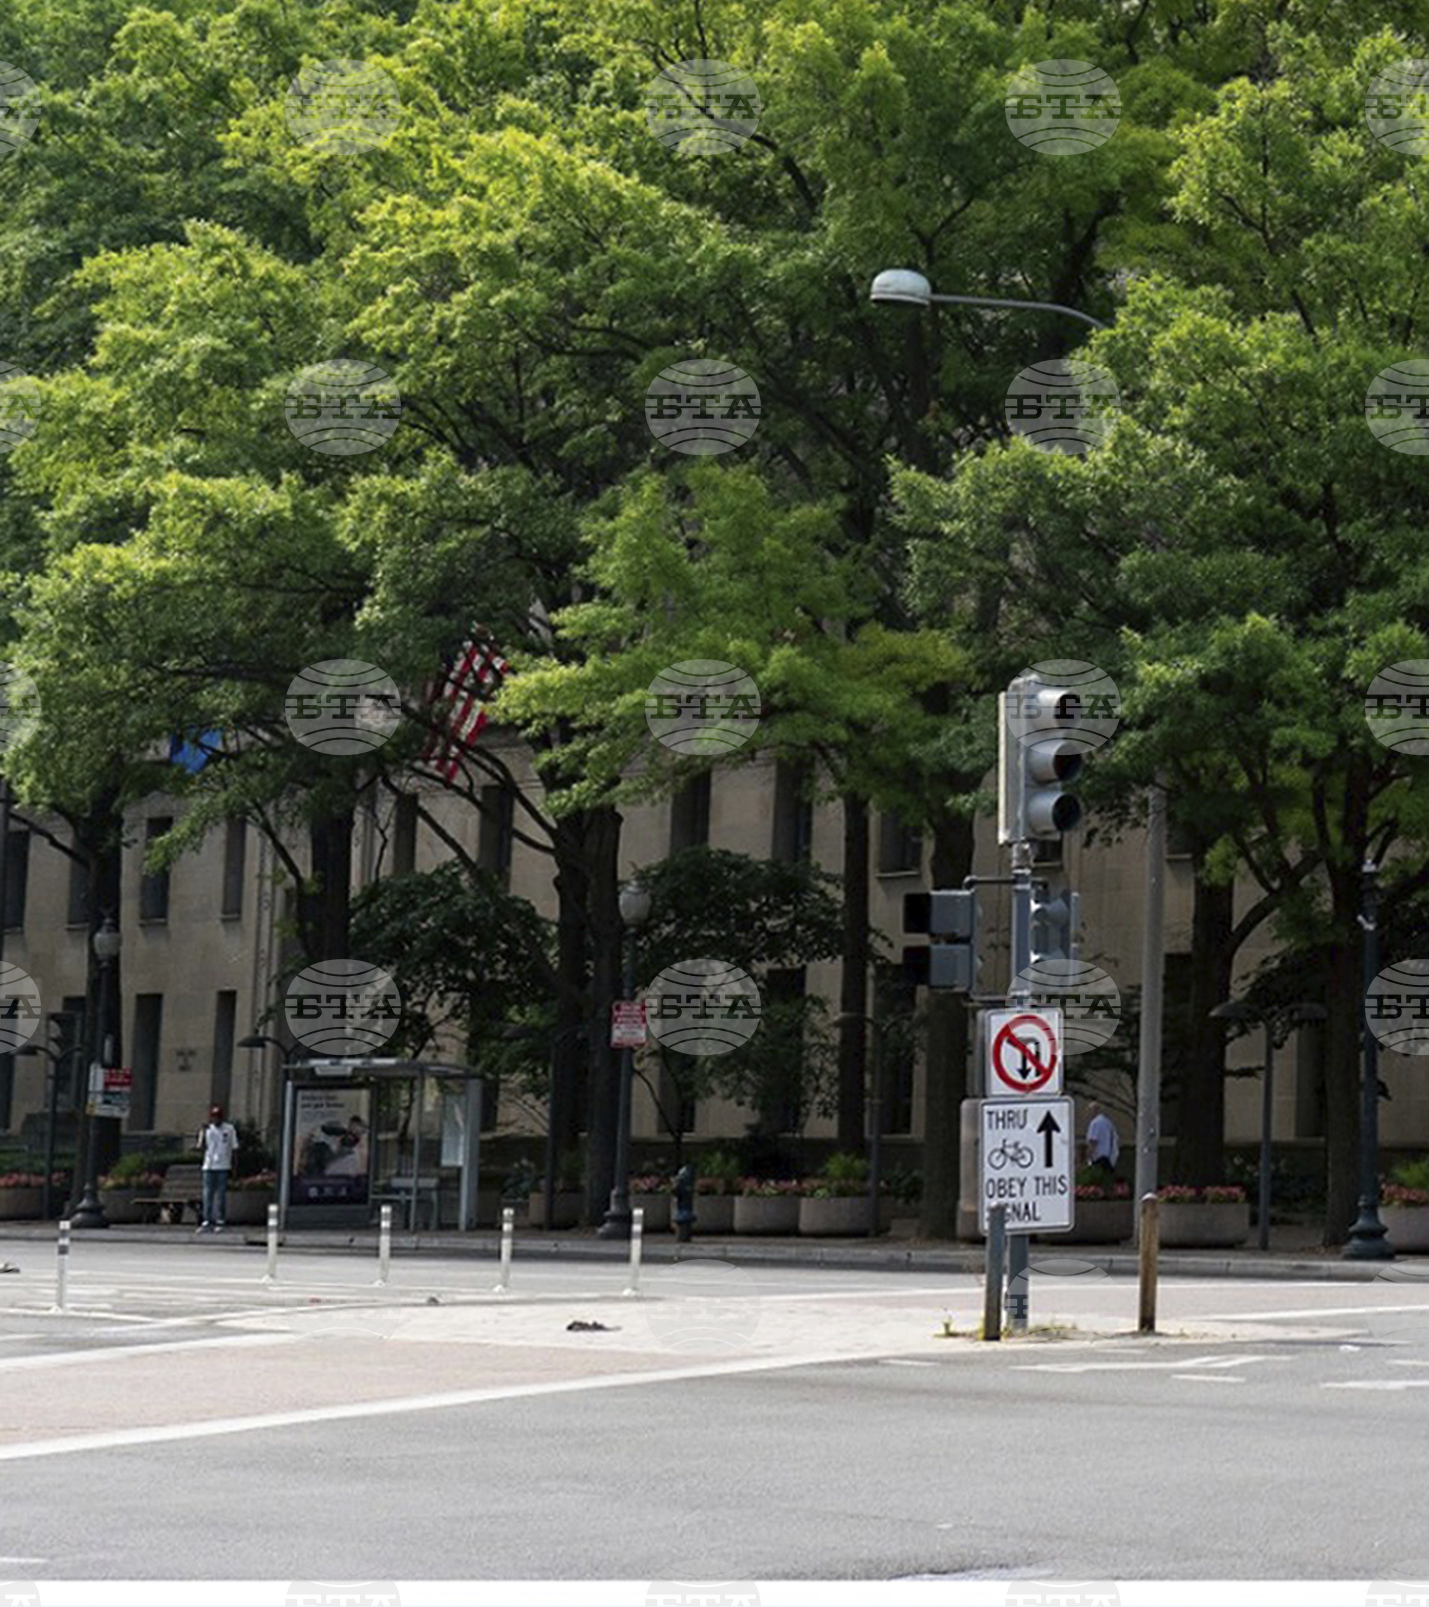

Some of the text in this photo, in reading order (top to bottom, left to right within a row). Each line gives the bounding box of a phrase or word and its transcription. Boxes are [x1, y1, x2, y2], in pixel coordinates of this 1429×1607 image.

[986, 1109, 1029, 1130] THRU
[985, 1174, 1068, 1199] OBEY THIS
